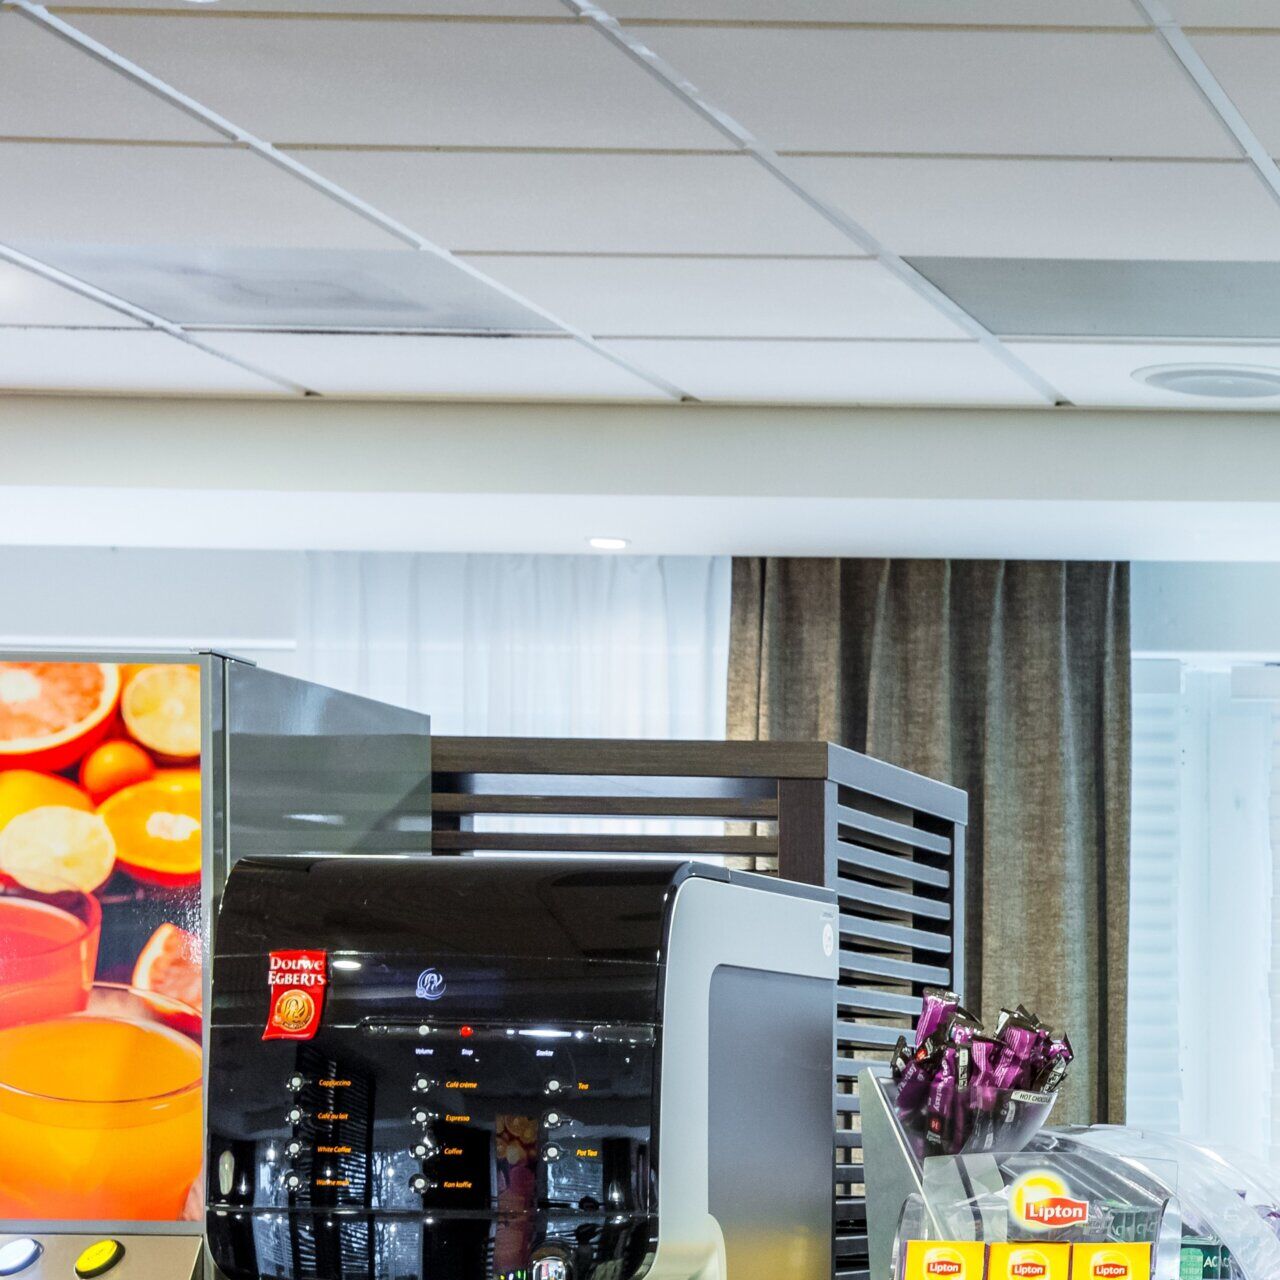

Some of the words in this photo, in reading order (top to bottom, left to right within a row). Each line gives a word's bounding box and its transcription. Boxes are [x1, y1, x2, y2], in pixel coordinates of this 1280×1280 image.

[270, 956, 324, 971] Douwe
[268, 971, 327, 986] EGBERTS
[318, 1079, 352, 1088] Cappuccino
[578, 1082, 590, 1090] Tea
[1019, 1092, 1032, 1100] HOT
[445, 1114, 471, 1122] Espresso
[444, 1147, 463, 1155] Coffee
[1029, 1203, 1083, 1221] Lipton
[929, 1263, 959, 1273] Lipton
[1013, 1264, 1043, 1275] Lipton
[1095, 1265, 1126, 1276] Lipton
